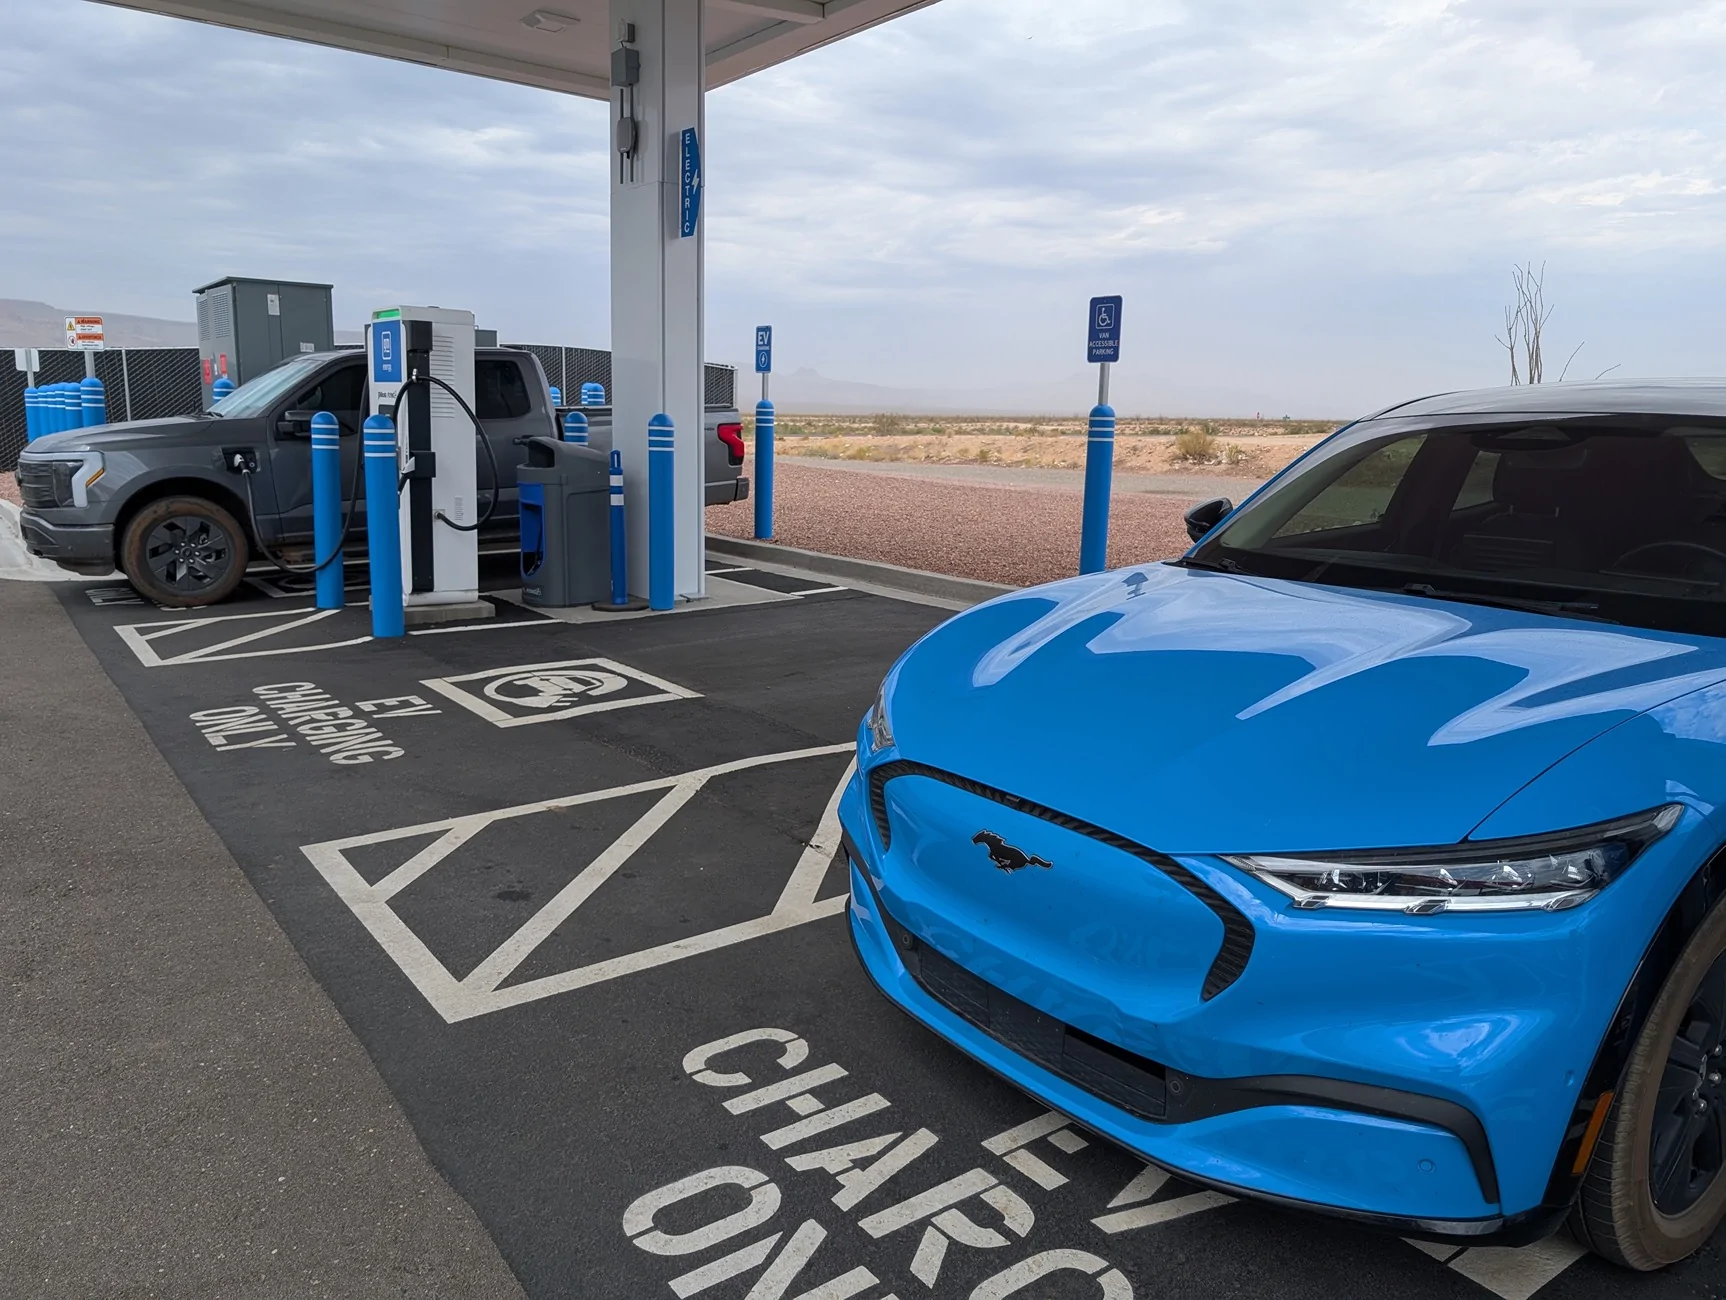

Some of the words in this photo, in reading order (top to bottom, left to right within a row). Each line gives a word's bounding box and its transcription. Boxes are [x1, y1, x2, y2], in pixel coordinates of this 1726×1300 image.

[757, 331, 770, 345] EV
[1088, 340, 1119, 348] ACCESSIBLE
[1092, 348, 1114, 356] PARKING
[354, 695, 443, 719] EV
[189, 706, 297, 752] ONLY
[252, 681, 405, 765] CHARGING
[623, 1166, 899, 1300] ON
